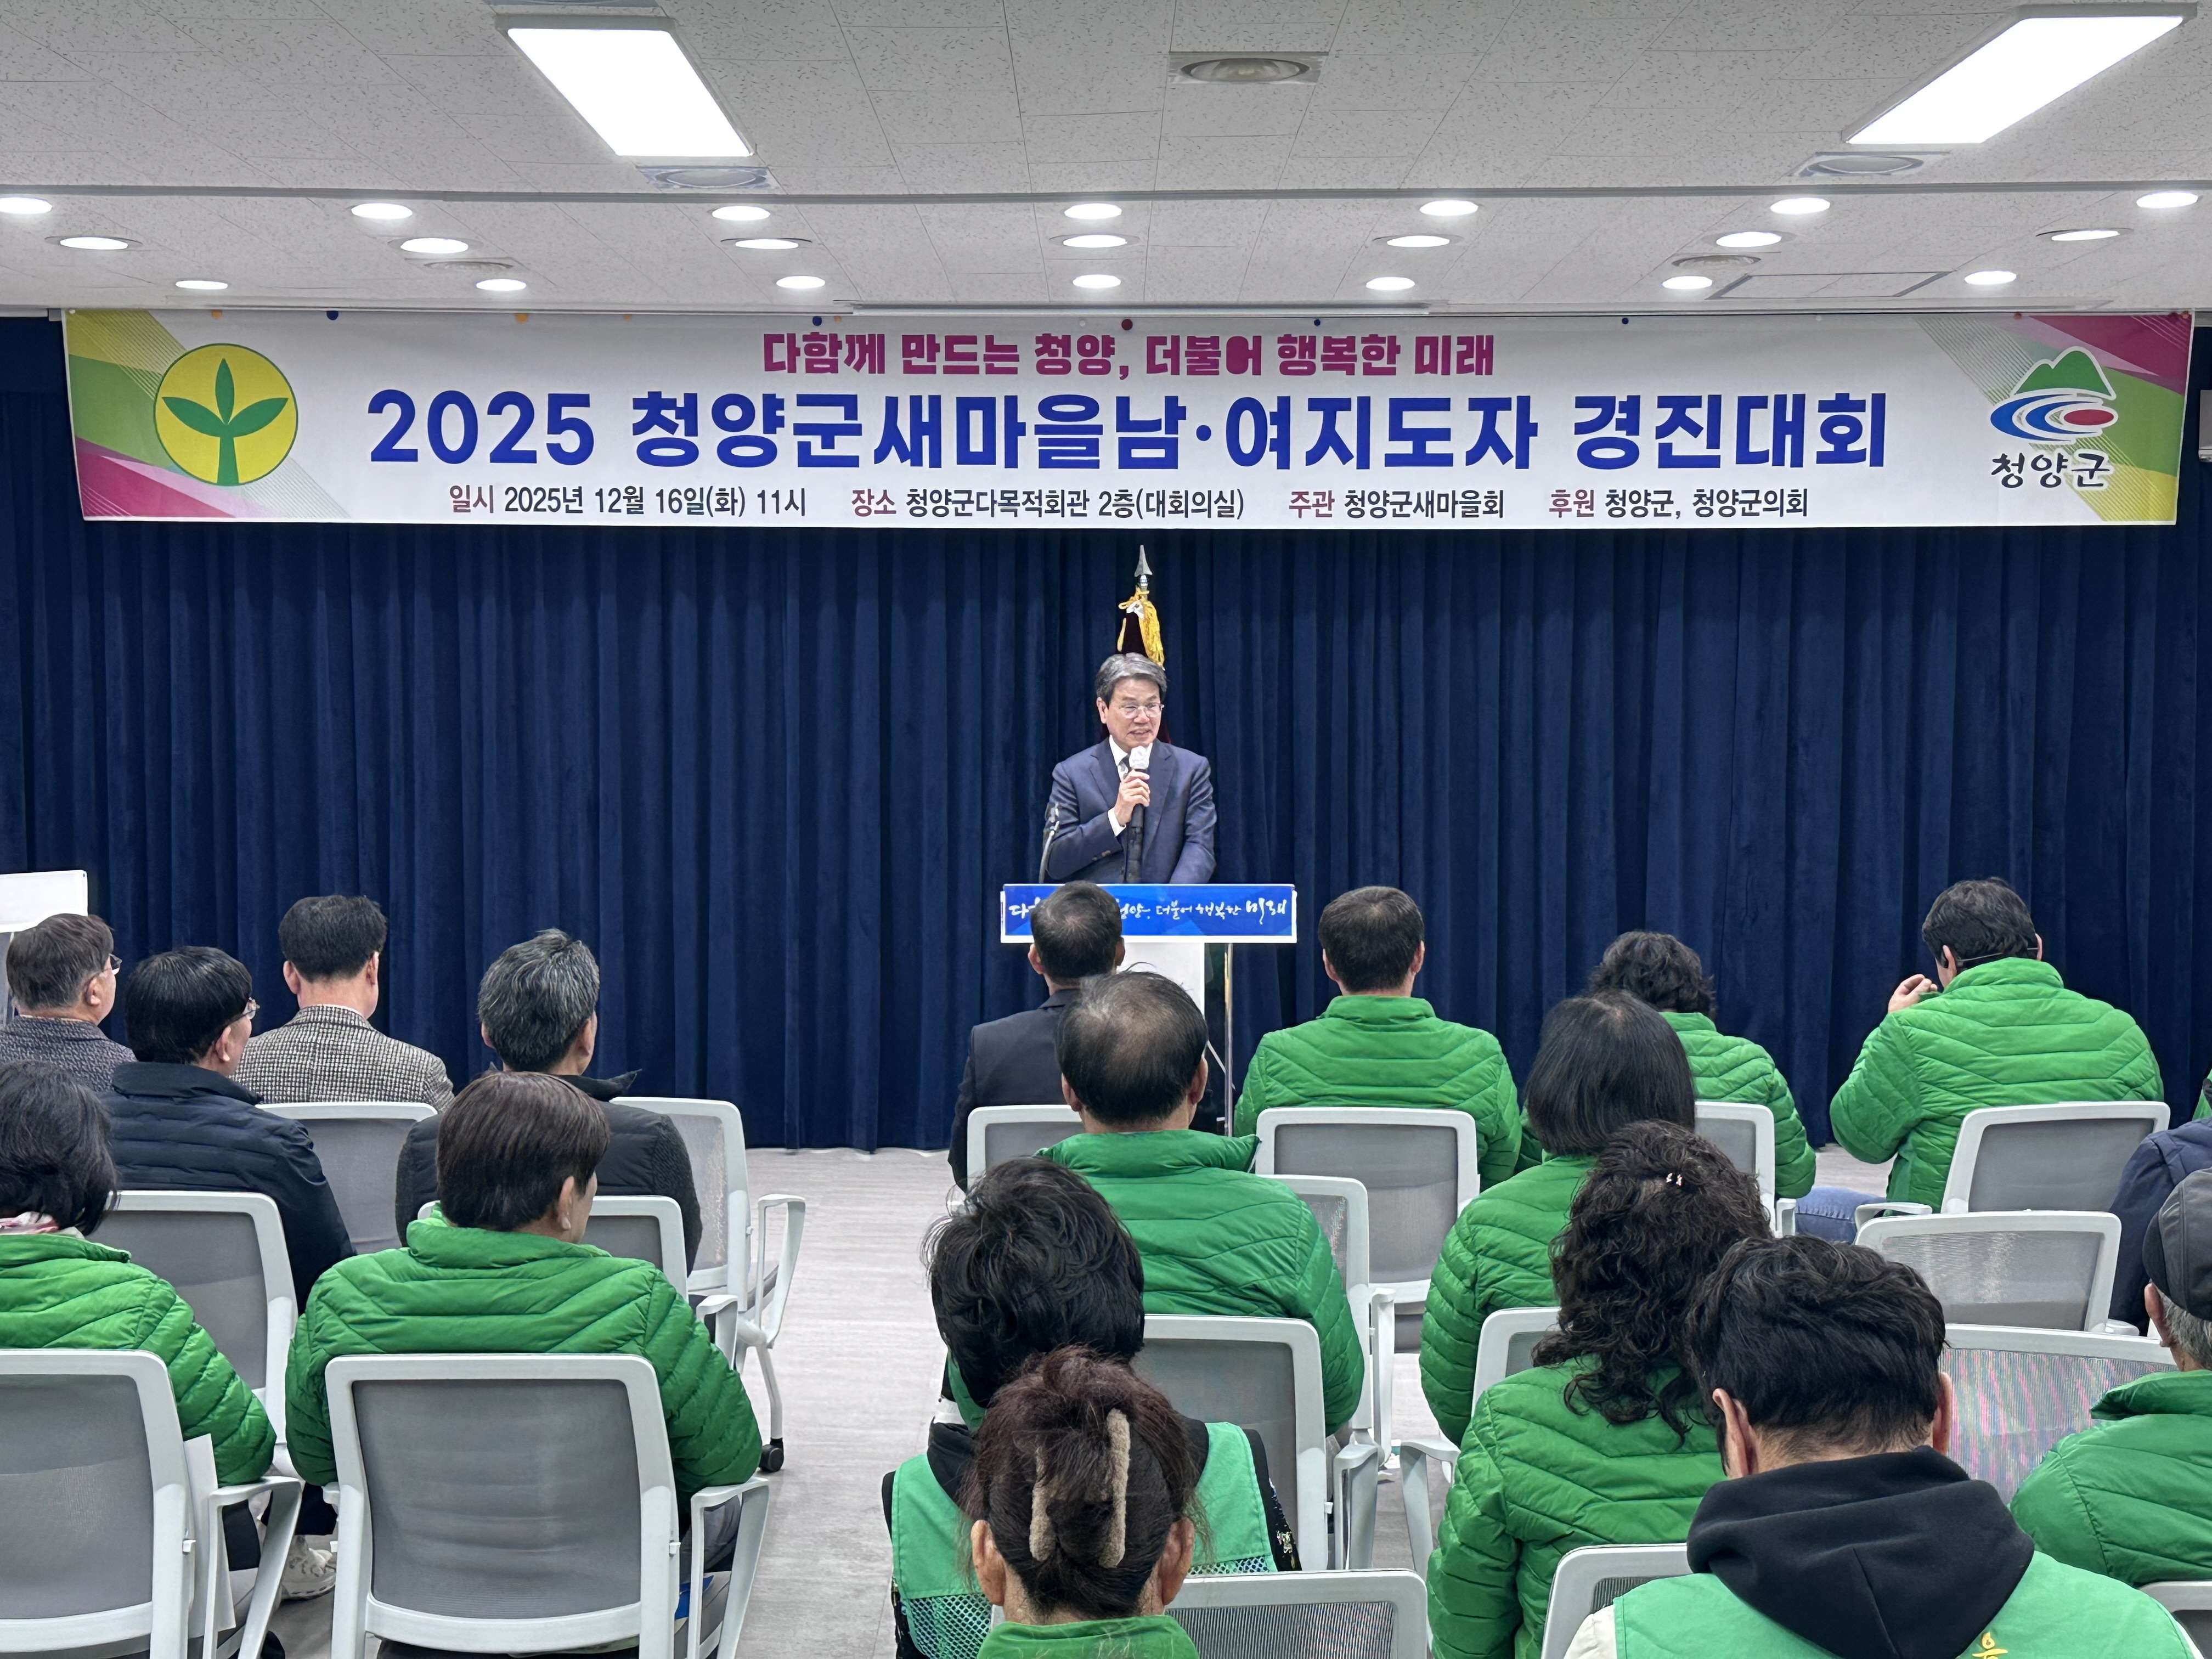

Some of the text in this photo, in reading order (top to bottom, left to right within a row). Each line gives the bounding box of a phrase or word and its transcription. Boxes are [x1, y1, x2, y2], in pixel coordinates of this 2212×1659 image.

[764, 332, 1493, 380] 다함께 만드는 청양, 더불어 행복한 미래
[368, 389, 594, 466] 2025
[1575, 393, 1886, 470] 경진대회
[1991, 453, 2111, 488] 청양군
[450, 485, 805, 517] 일시 2025년 12월 16일(화) 11시
[851, 489, 1244, 519] 장소 청양군다목적회관 2층(대회의실)
[1289, 490, 1504, 518] 주관 청양군새마을회
[1550, 489, 1808, 519] 후원 청양군, 청양군의회
[1156, 900, 1192, 920] 더불어
[1195, 902, 1242, 920] 행복한
[1245, 898, 1287, 925] 미래
